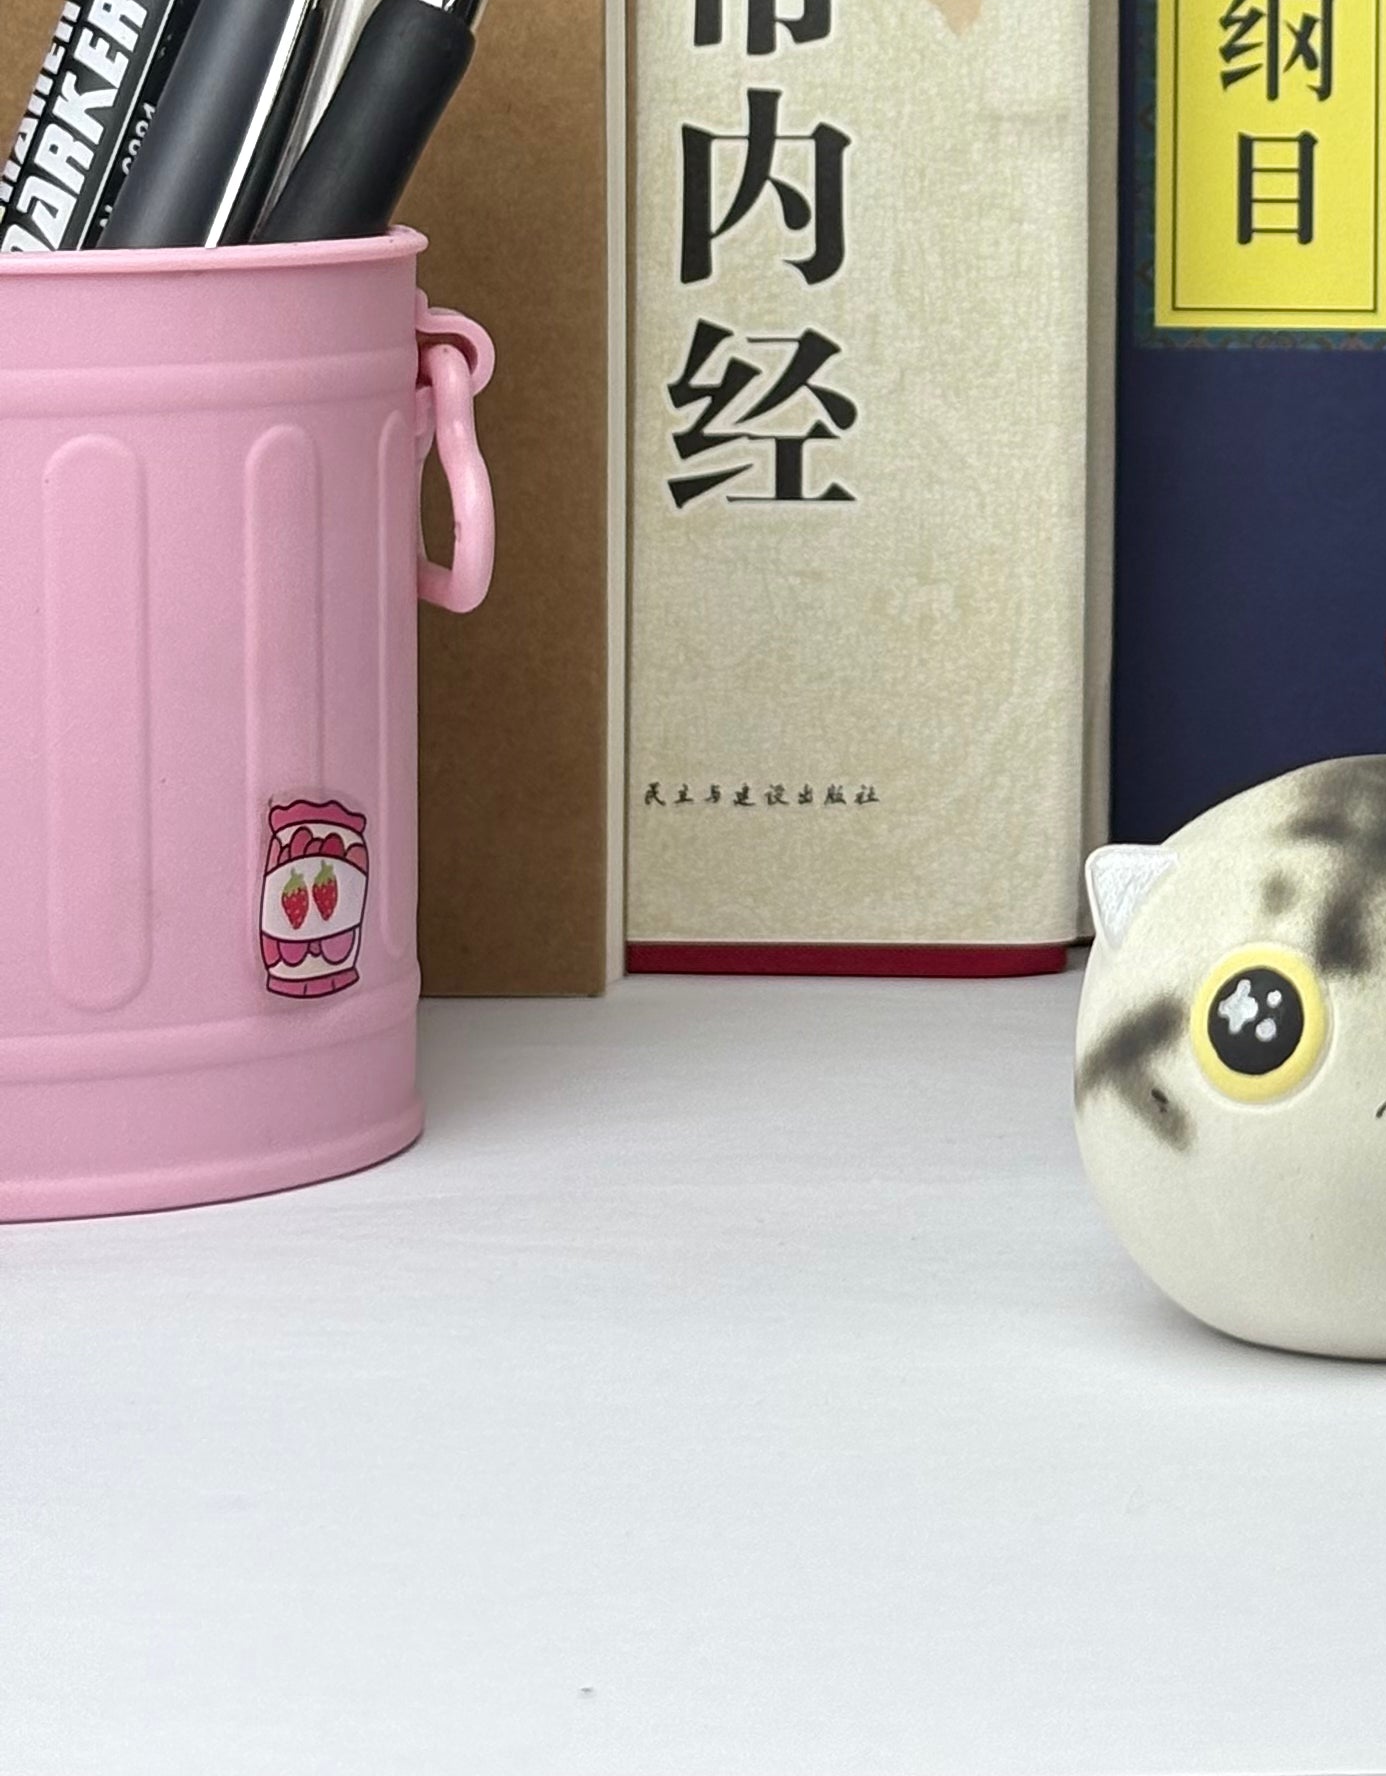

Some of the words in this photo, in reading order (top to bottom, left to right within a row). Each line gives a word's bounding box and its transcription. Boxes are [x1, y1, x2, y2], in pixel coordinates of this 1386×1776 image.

[644, 781, 881, 807] 民主与建设出版社
